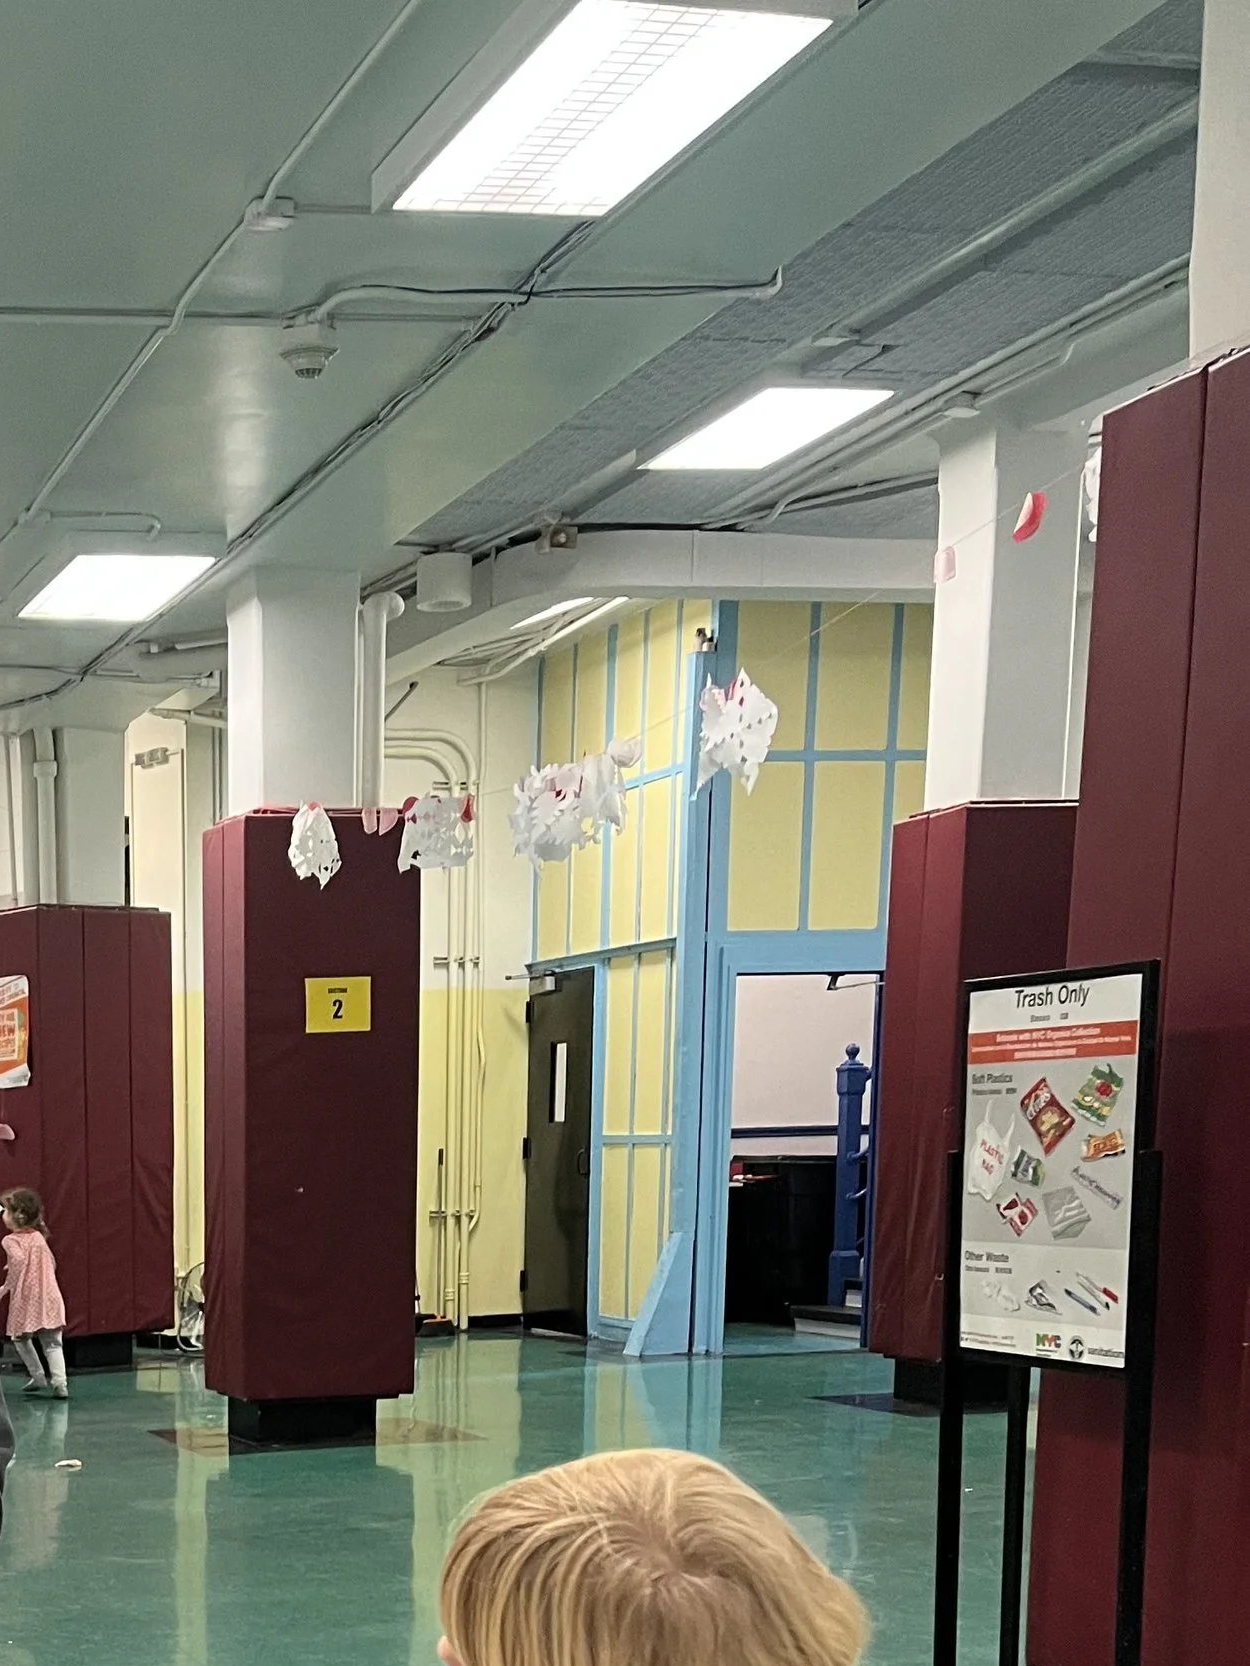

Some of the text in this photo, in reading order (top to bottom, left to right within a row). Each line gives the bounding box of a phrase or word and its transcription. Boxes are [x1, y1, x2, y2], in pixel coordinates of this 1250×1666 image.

[1015, 983, 1090, 1008] Trash Only
[333, 999, 342, 1019] 2
[1036, 1333, 1062, 1349] NYC
